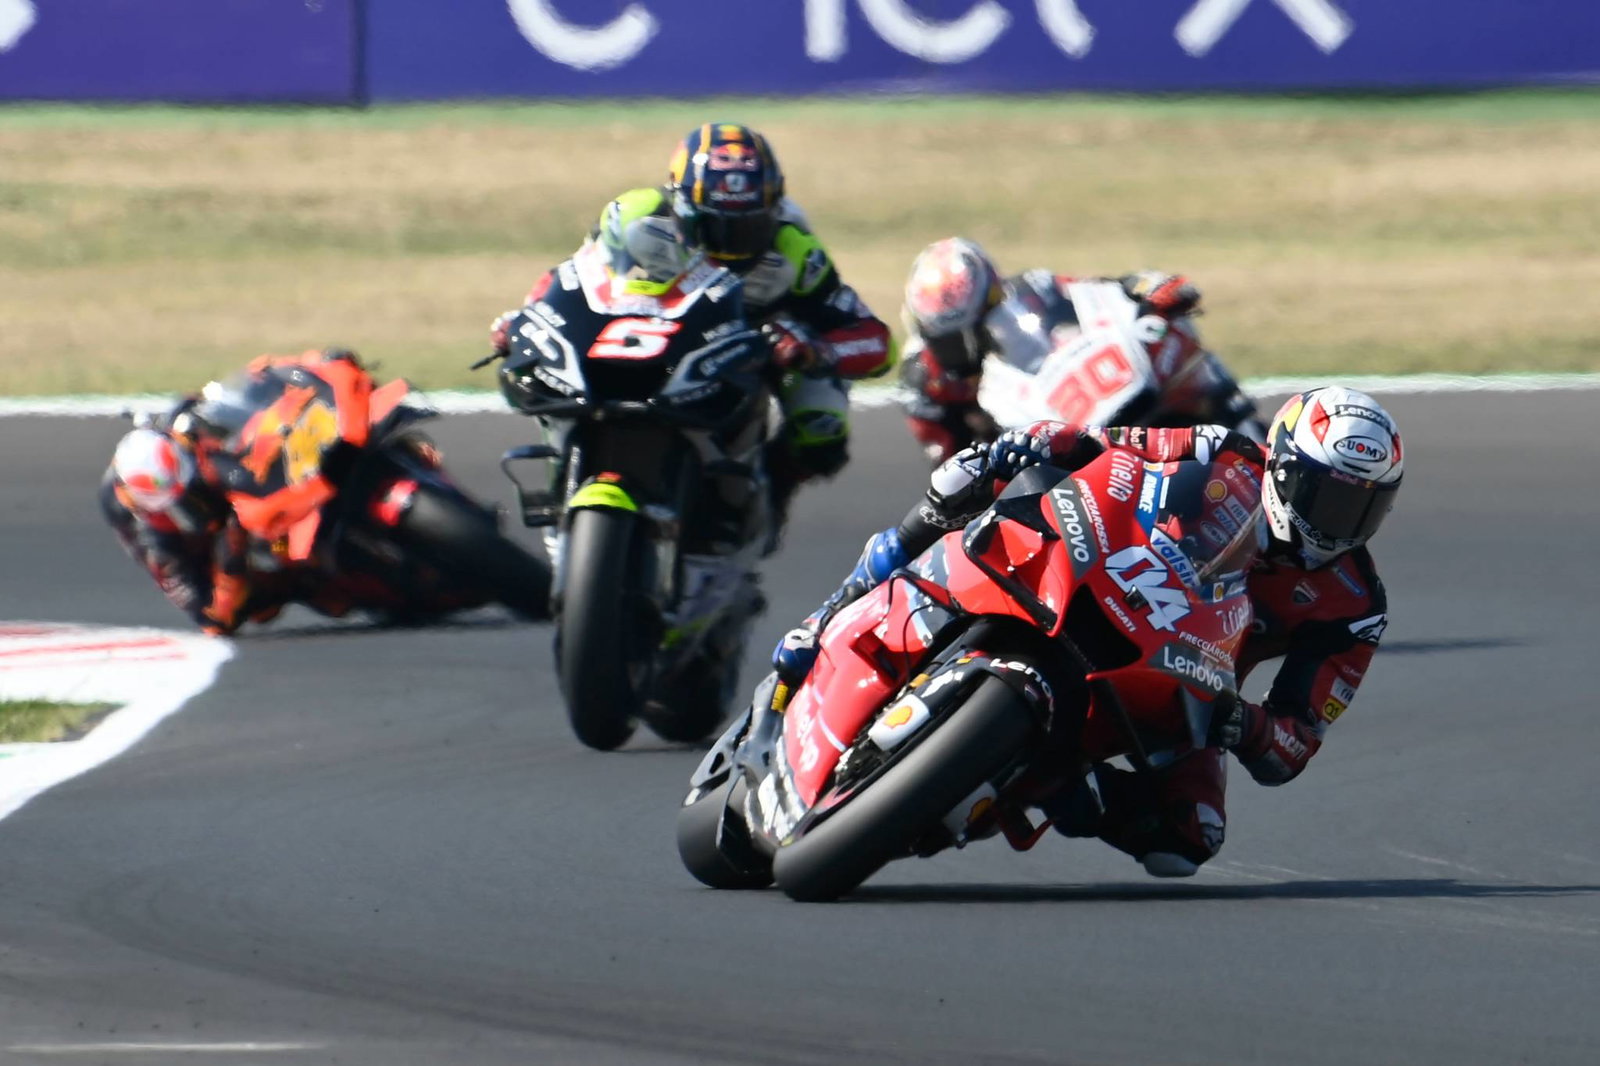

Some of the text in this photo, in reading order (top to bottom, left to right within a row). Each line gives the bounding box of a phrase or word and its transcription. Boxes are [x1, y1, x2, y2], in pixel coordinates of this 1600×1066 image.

[1338, 440, 1386, 459] SUOMY
[1052, 488, 1090, 563] Lenovo
[1075, 478, 1110, 553] FRECCIAROSSA
[1104, 596, 1137, 632] DUCATI
[1105, 545, 1191, 632] 04
[1164, 647, 1223, 691] Lenovo
